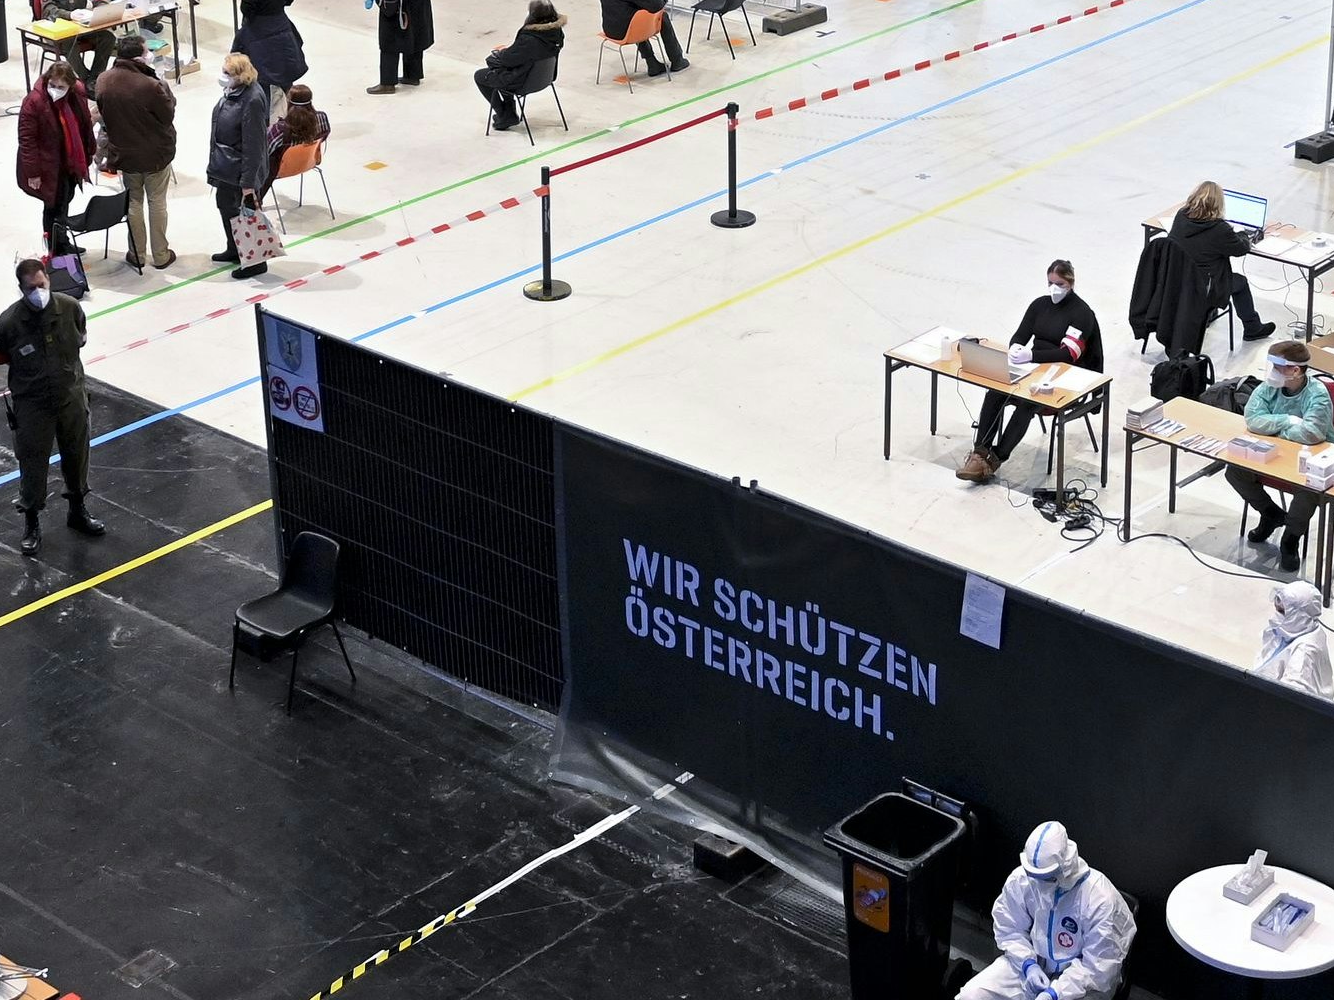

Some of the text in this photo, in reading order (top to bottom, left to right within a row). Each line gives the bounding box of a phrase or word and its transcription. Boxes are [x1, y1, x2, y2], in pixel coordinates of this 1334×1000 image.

[623, 538, 700, 607] WIR
[713, 578, 937, 706] SCHÜTZEN
[624, 585, 895, 741] ÖSTERREICH.
